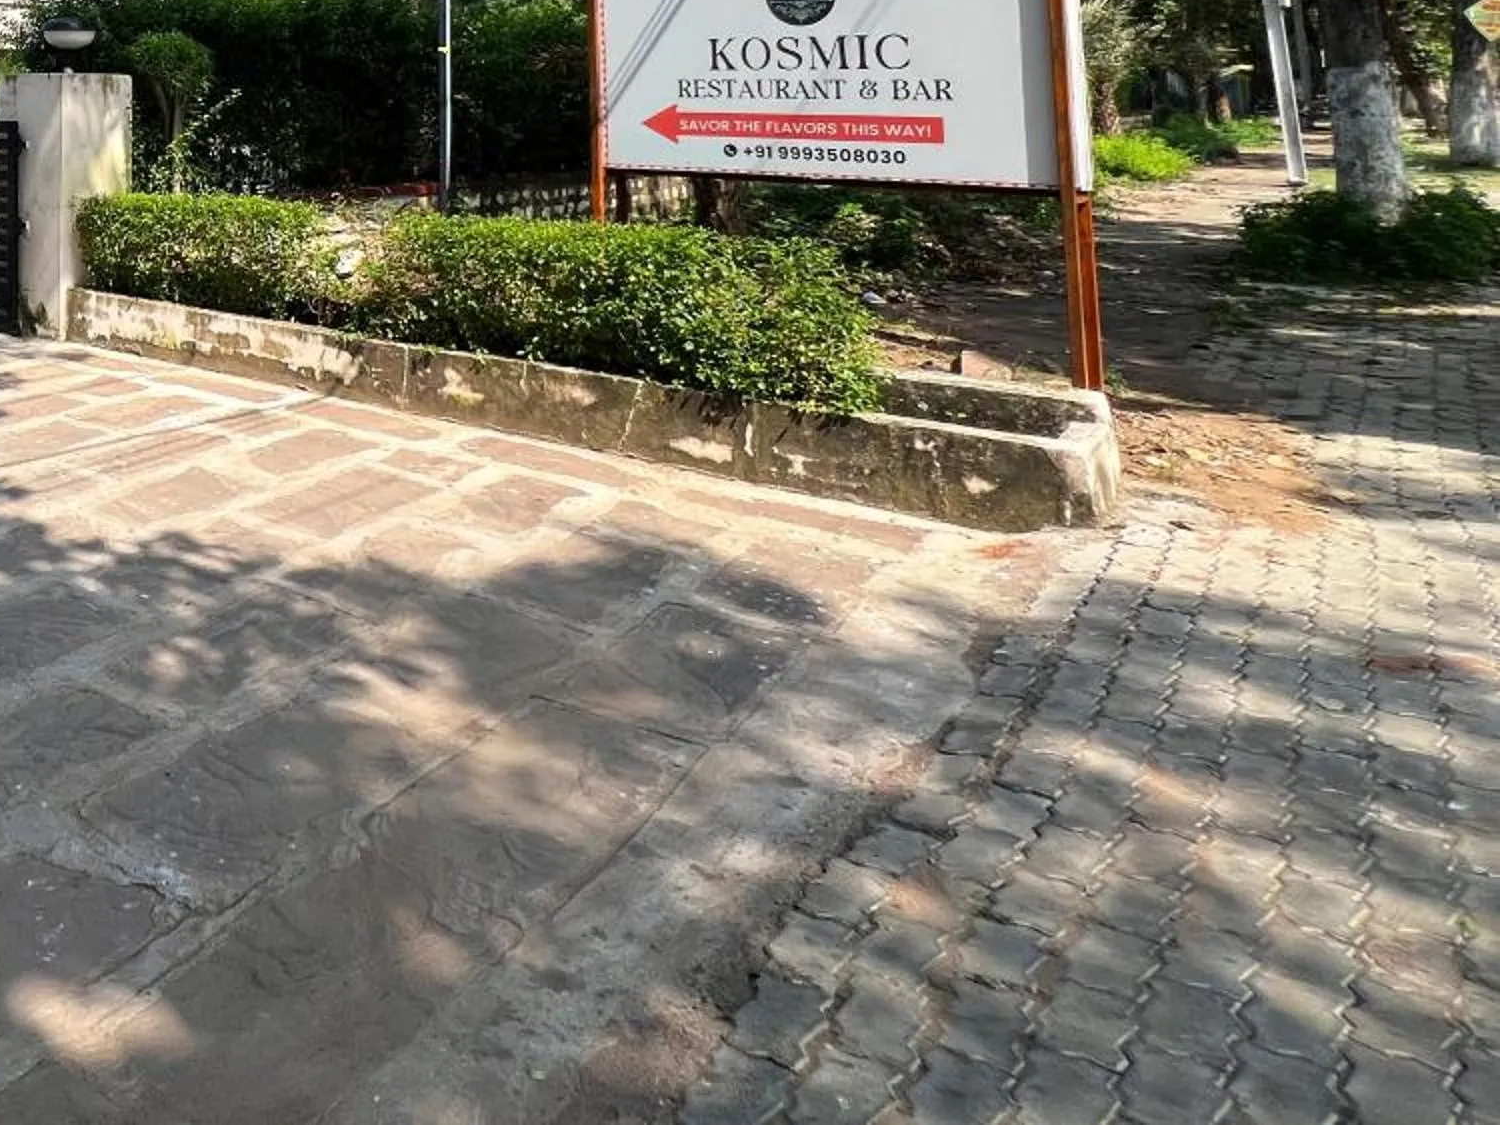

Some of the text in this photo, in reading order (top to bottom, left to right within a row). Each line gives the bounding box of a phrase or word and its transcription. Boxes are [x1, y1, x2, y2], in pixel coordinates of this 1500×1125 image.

[709, 33, 911, 72] KOSMIC
[678, 78, 954, 102] RESTAURANT & BAR
[679, 119, 933, 139] SAVOR THE FLAVORS THIS WAY!
[743, 144, 907, 165] +91 9993508030
